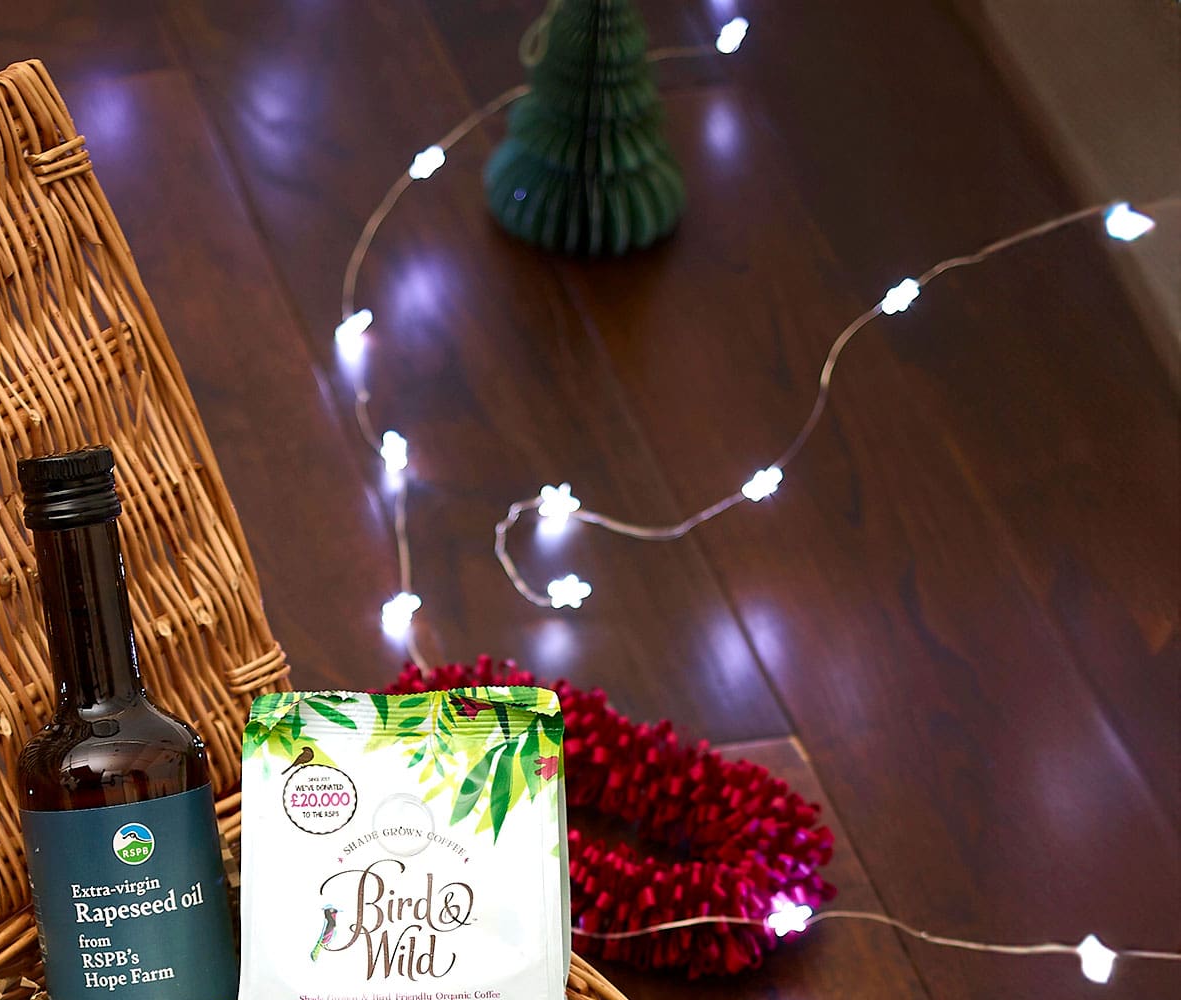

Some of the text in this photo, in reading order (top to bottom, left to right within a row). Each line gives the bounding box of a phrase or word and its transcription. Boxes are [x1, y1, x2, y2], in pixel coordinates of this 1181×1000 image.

[302, 810, 311, 818] TO
[312, 810, 323, 818] THE
[122, 846, 149, 859] RSPB
[342, 826, 467, 857] SHADE GROWN COFFEE
[71, 876, 161, 899] Extra-virgin
[74, 882, 204, 928] Rapeseed oil
[320, 859, 475, 952] Bird &
[78, 933, 112, 949] from
[81, 948, 140, 969] RSPB's
[349, 924, 457, 982] Wild
[84, 966, 175, 992] Hope Farm
[474, 990, 501, 1000] Coffee
